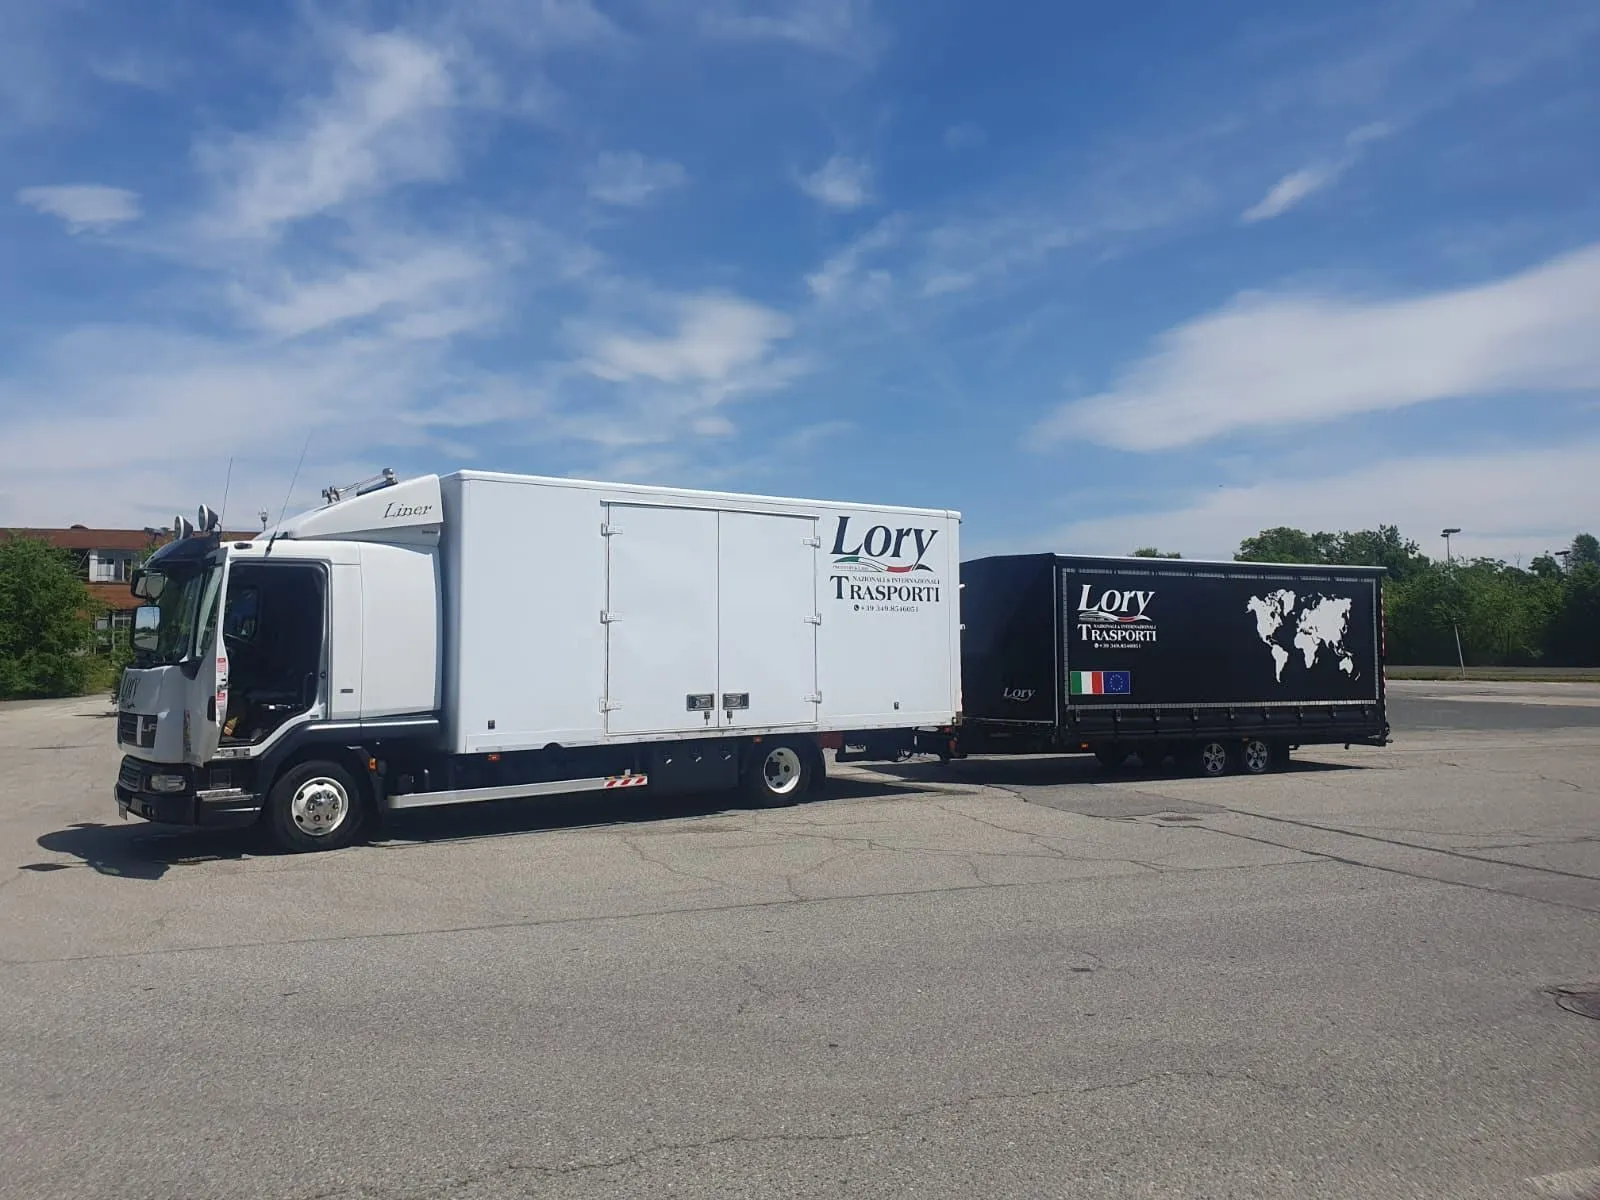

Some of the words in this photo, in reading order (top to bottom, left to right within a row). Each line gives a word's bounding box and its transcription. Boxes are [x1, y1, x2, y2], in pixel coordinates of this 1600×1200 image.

[383, 501, 433, 518] Liner
[830, 515, 939, 571] Lory
[1077, 584, 1156, 616] Lory
[1003, 687, 1036, 700] Lory
